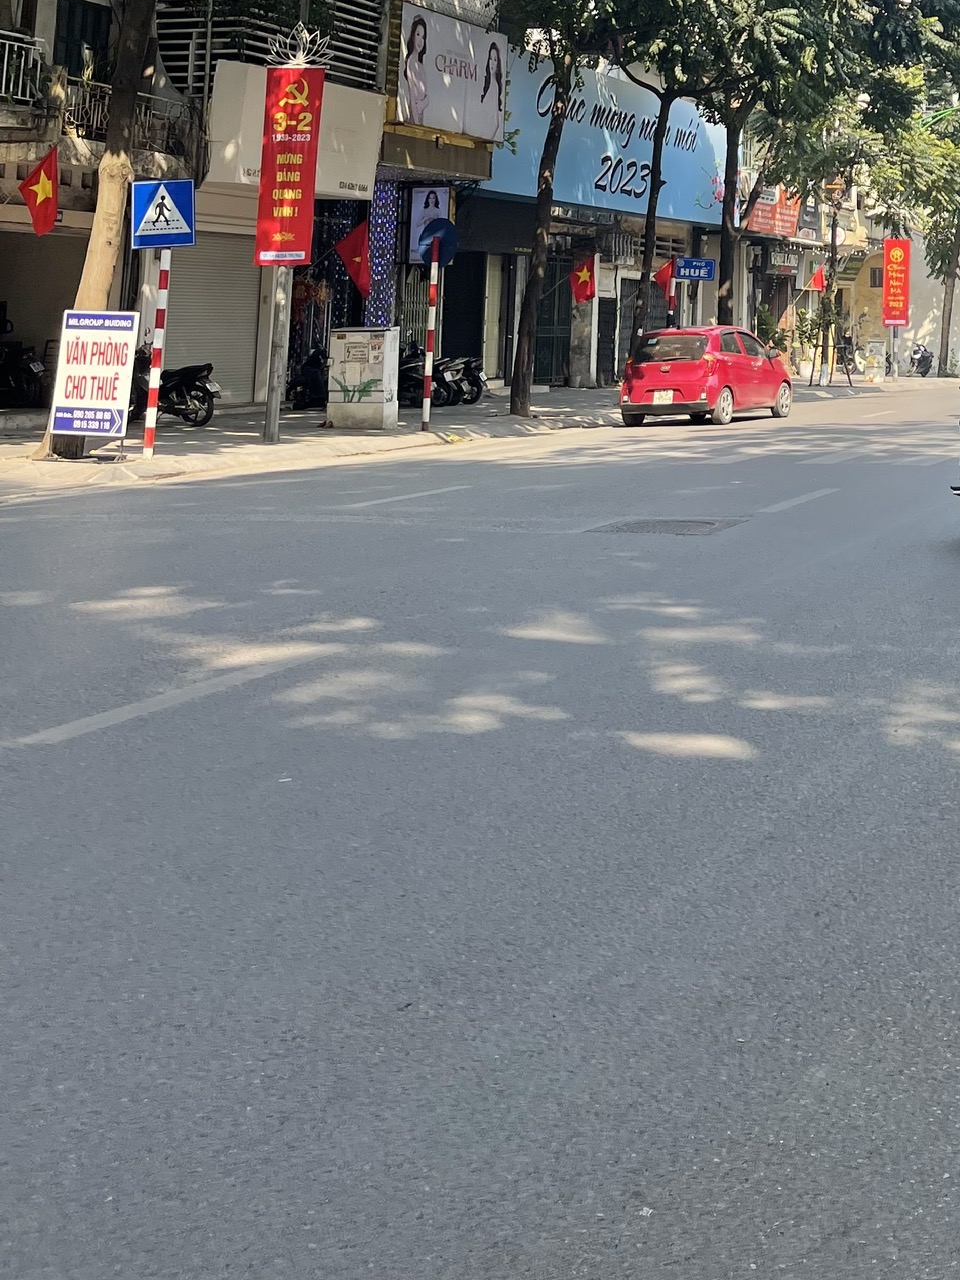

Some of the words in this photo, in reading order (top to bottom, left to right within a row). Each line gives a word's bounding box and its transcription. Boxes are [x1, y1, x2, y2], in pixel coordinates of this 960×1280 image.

[435, 53, 477, 82] CHARM
[273, 112, 313, 131] 3-2
[595, 155, 651, 199] 2023
[272, 188, 302, 201] QUANG
[680, 266, 711, 278] HUẾ
[66, 336, 88, 365] VĂN
[90, 337, 129, 367] PHÒNG
[64, 375, 87, 400] CHO
[90, 372, 120, 401] THUÊ
